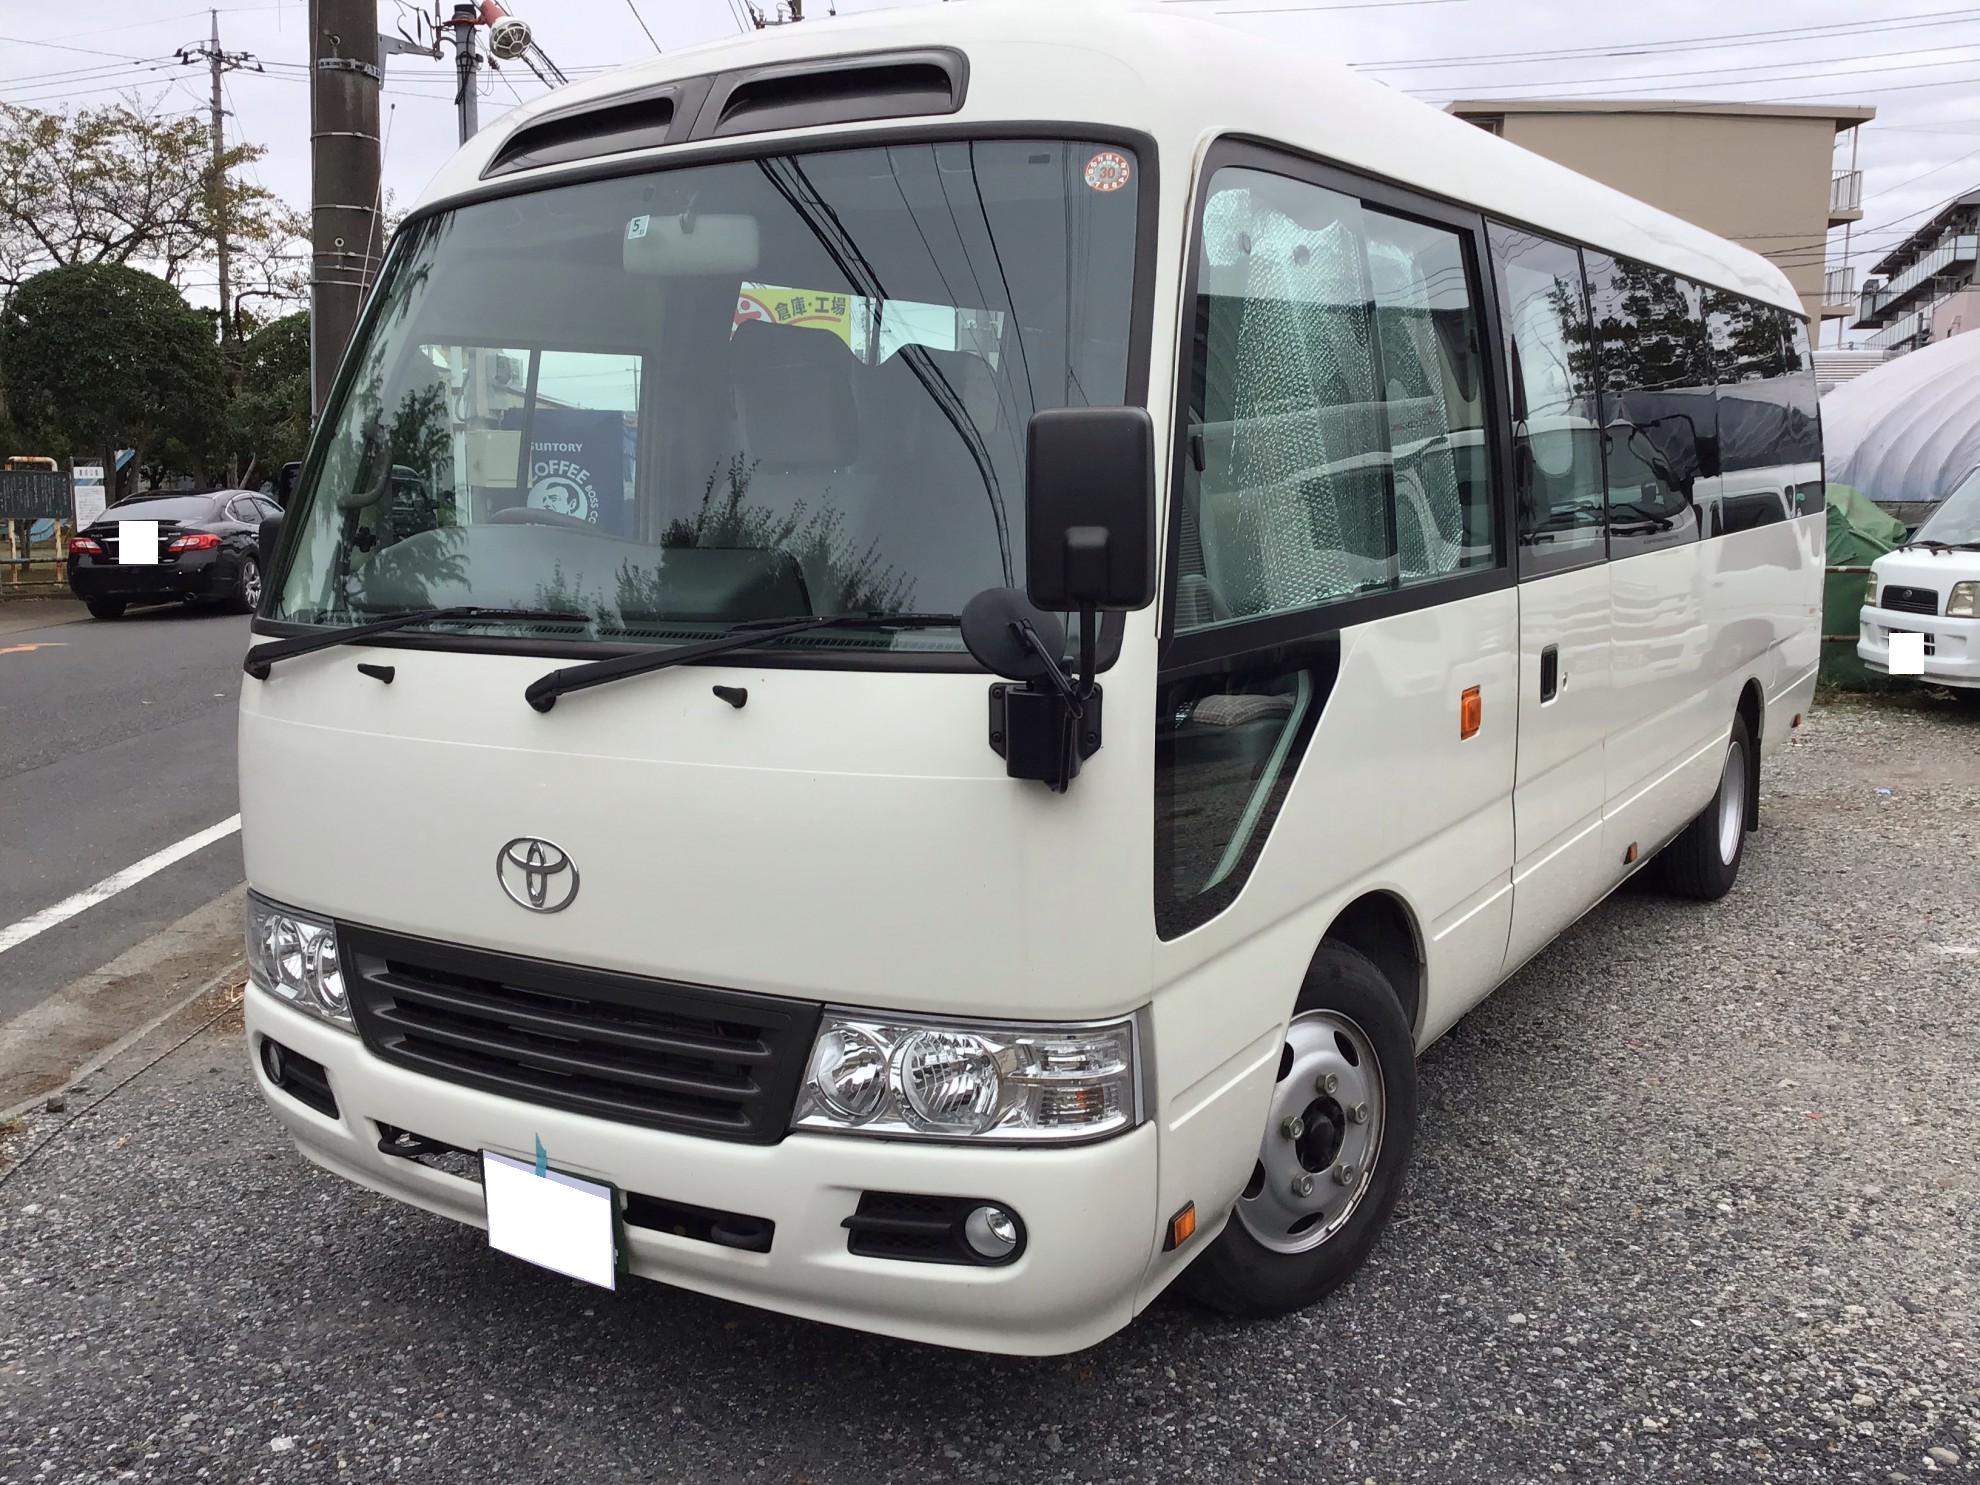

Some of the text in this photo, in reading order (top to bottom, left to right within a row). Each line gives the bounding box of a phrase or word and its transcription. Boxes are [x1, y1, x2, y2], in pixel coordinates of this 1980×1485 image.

[1100, 167, 1115, 179] 30
[632, 219, 641, 232] 5
[532, 460, 590, 485] OFFEE
[585, 485, 598, 508] BOSS
